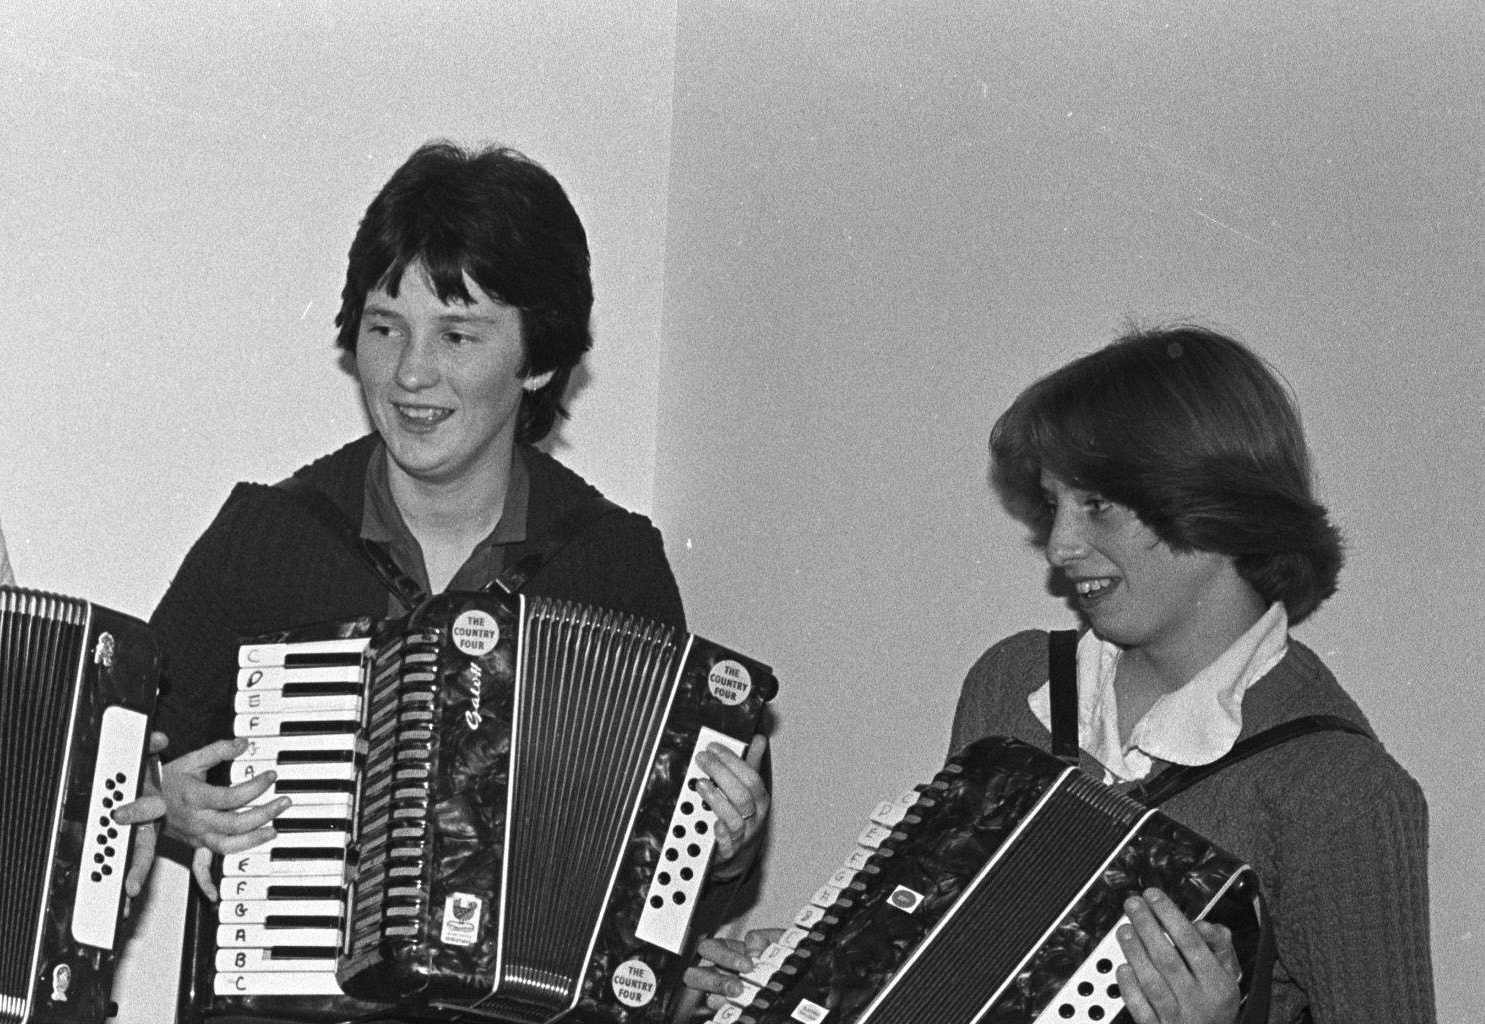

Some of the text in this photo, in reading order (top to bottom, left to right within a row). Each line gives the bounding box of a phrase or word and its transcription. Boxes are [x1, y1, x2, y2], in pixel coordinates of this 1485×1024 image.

[468, 616, 485, 626] THE
[453, 627, 495, 639] COUNTRY
[460, 639, 484, 650] FOUR
[247, 649, 260, 663] C
[246, 670, 263, 688] D
[725, 666, 740, 678] THE
[710, 673, 748, 692] COUNTRY
[248, 694, 260, 708] E
[714, 687, 737, 701] FOUR
[249, 717, 260, 731] F
[244, 765, 255, 780] A
[238, 857, 250, 872] E
[237, 881, 247, 895] F
[235, 929, 246, 942] A
[235, 952, 246, 968] B
[628, 966, 644, 978] THE
[235, 976, 246, 991] C
[614, 975, 653, 992] COUNTRY
[618, 988, 642, 1002] FOUR
[722, 1007, 735, 1020] G
